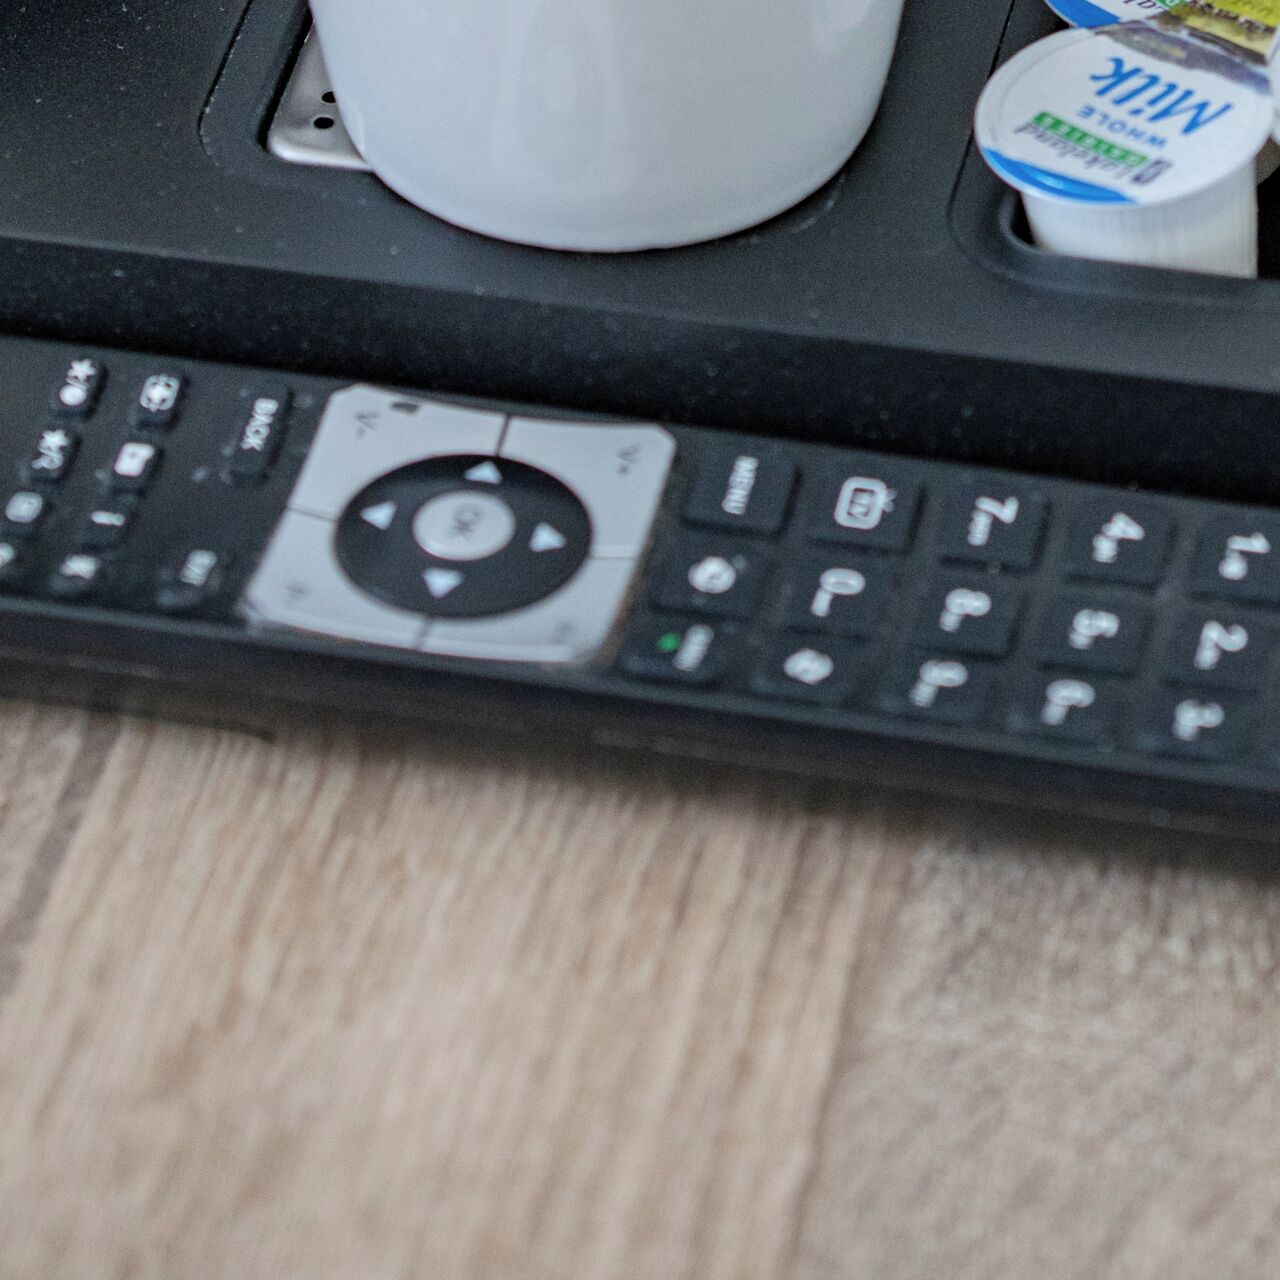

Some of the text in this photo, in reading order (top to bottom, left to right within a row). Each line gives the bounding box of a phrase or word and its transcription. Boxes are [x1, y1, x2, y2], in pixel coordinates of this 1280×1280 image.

[1089, 56, 1233, 137] Milk
[1076, 103, 1168, 148] WHOLE
[975, 496, 1019, 524] 7
[1101, 512, 1145, 541] 4
[1201, 620, 1249, 652] 2
